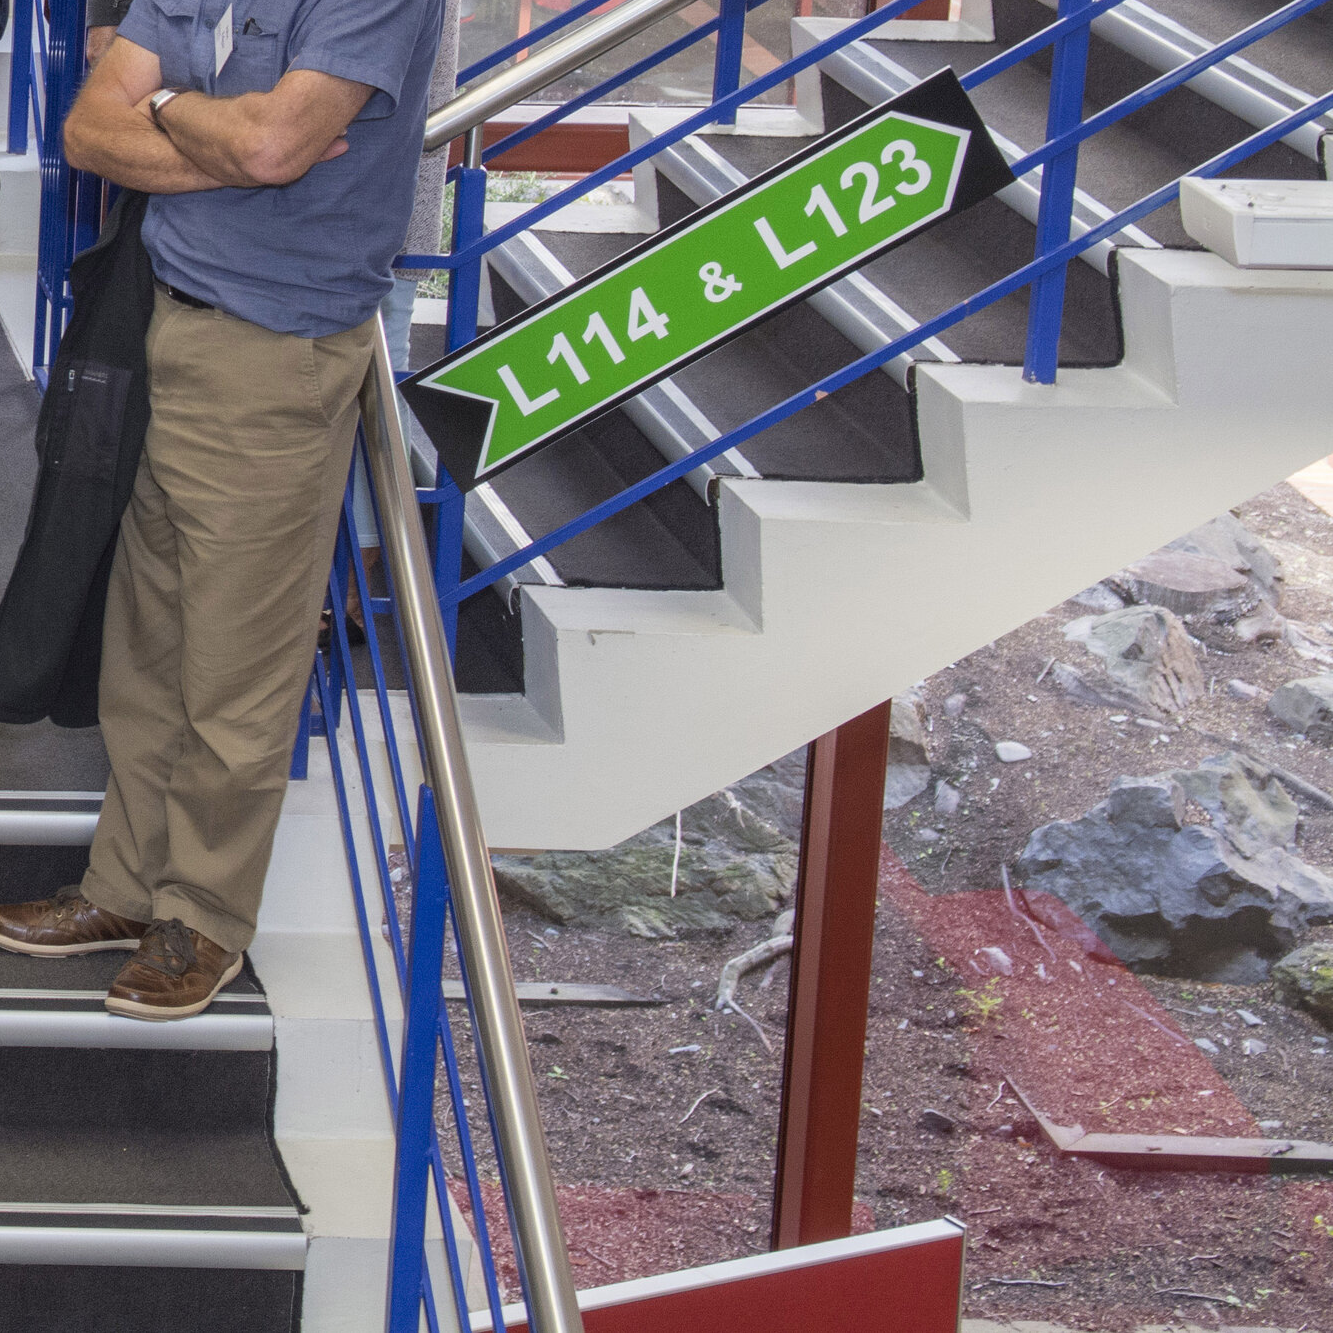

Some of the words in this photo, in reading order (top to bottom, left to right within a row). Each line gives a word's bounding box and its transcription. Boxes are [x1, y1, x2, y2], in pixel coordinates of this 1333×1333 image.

[496, 286, 670, 417] L114
[698, 260, 743, 303] &
[753, 138, 932, 271] L123
